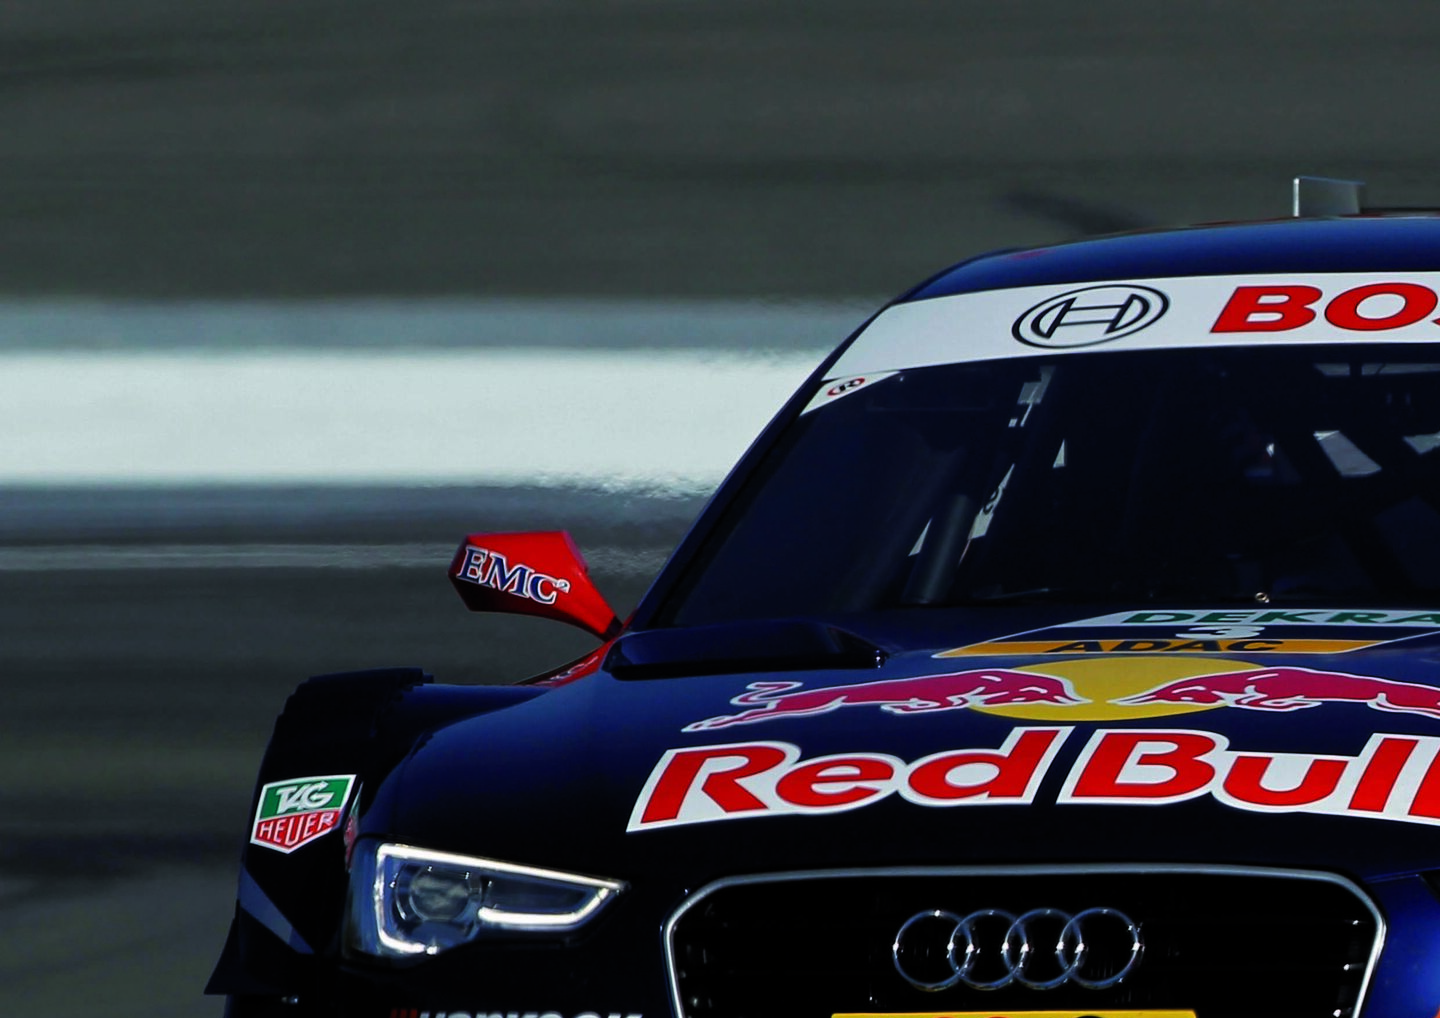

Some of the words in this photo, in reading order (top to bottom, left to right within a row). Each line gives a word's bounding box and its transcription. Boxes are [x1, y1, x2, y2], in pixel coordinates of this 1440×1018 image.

[1045, 640, 1284, 653] ADAC
[1175, 626, 1266, 639] 3
[626, 726, 1076, 833] Red
[276, 780, 335, 814] TAG
[259, 812, 335, 846] HEUER
